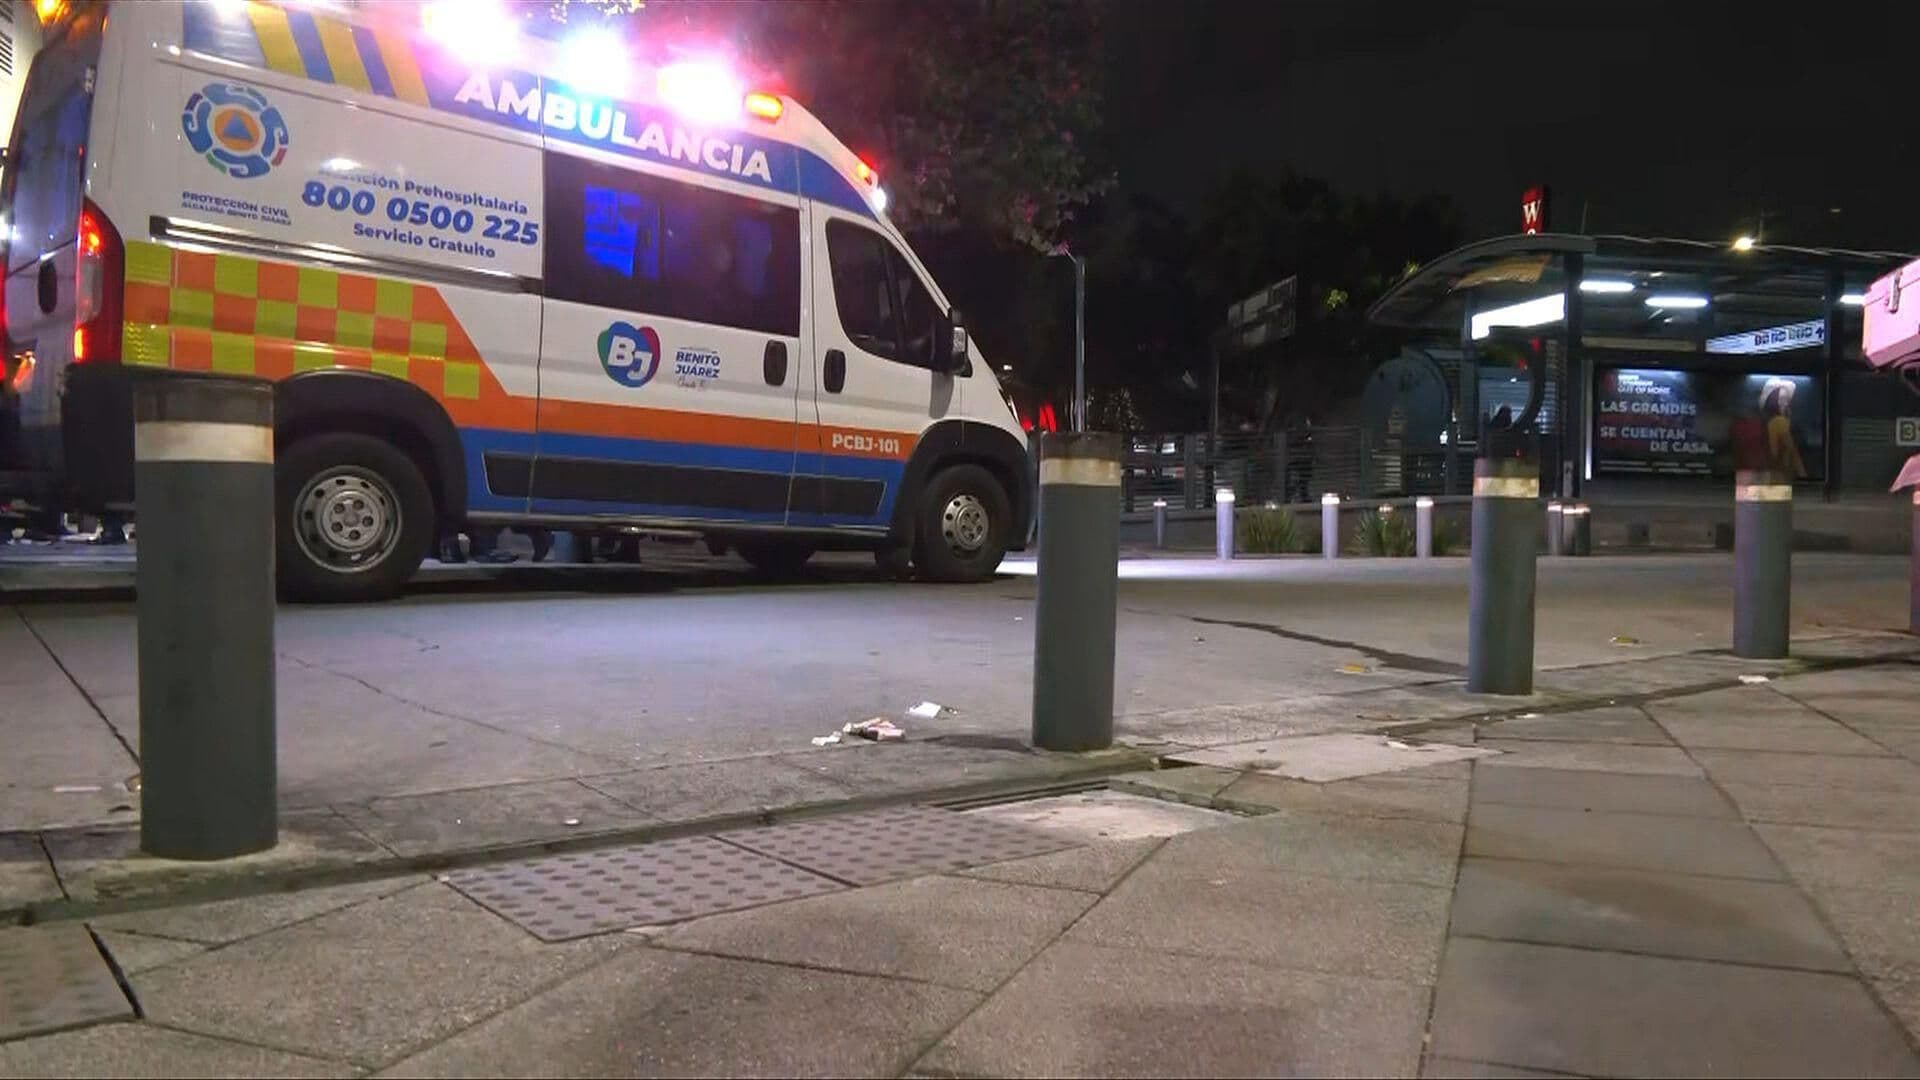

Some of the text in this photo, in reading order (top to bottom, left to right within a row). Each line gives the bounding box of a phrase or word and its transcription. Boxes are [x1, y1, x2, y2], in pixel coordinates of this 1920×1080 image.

[454, 71, 773, 182] AMBULANCIA
[404, 180, 528, 216] Prehospitalaria
[260, 205, 289, 218] CIVIL
[302, 180, 539, 246] 800 0500 225
[1522, 199, 1542, 225] W
[353, 222, 497, 259] Servicio Gratuito
[607, 335, 653, 380] BJ
[675, 351, 721, 366] BENITO
[674, 363, 720, 378] JUÁREZ
[1600, 400, 1697, 416] LAS GRANDES
[832, 432, 901, 455] PCBJ-101
[1600, 426, 1687, 440] SE CUENTAN
[1649, 441, 1715, 454] DE CASA.
